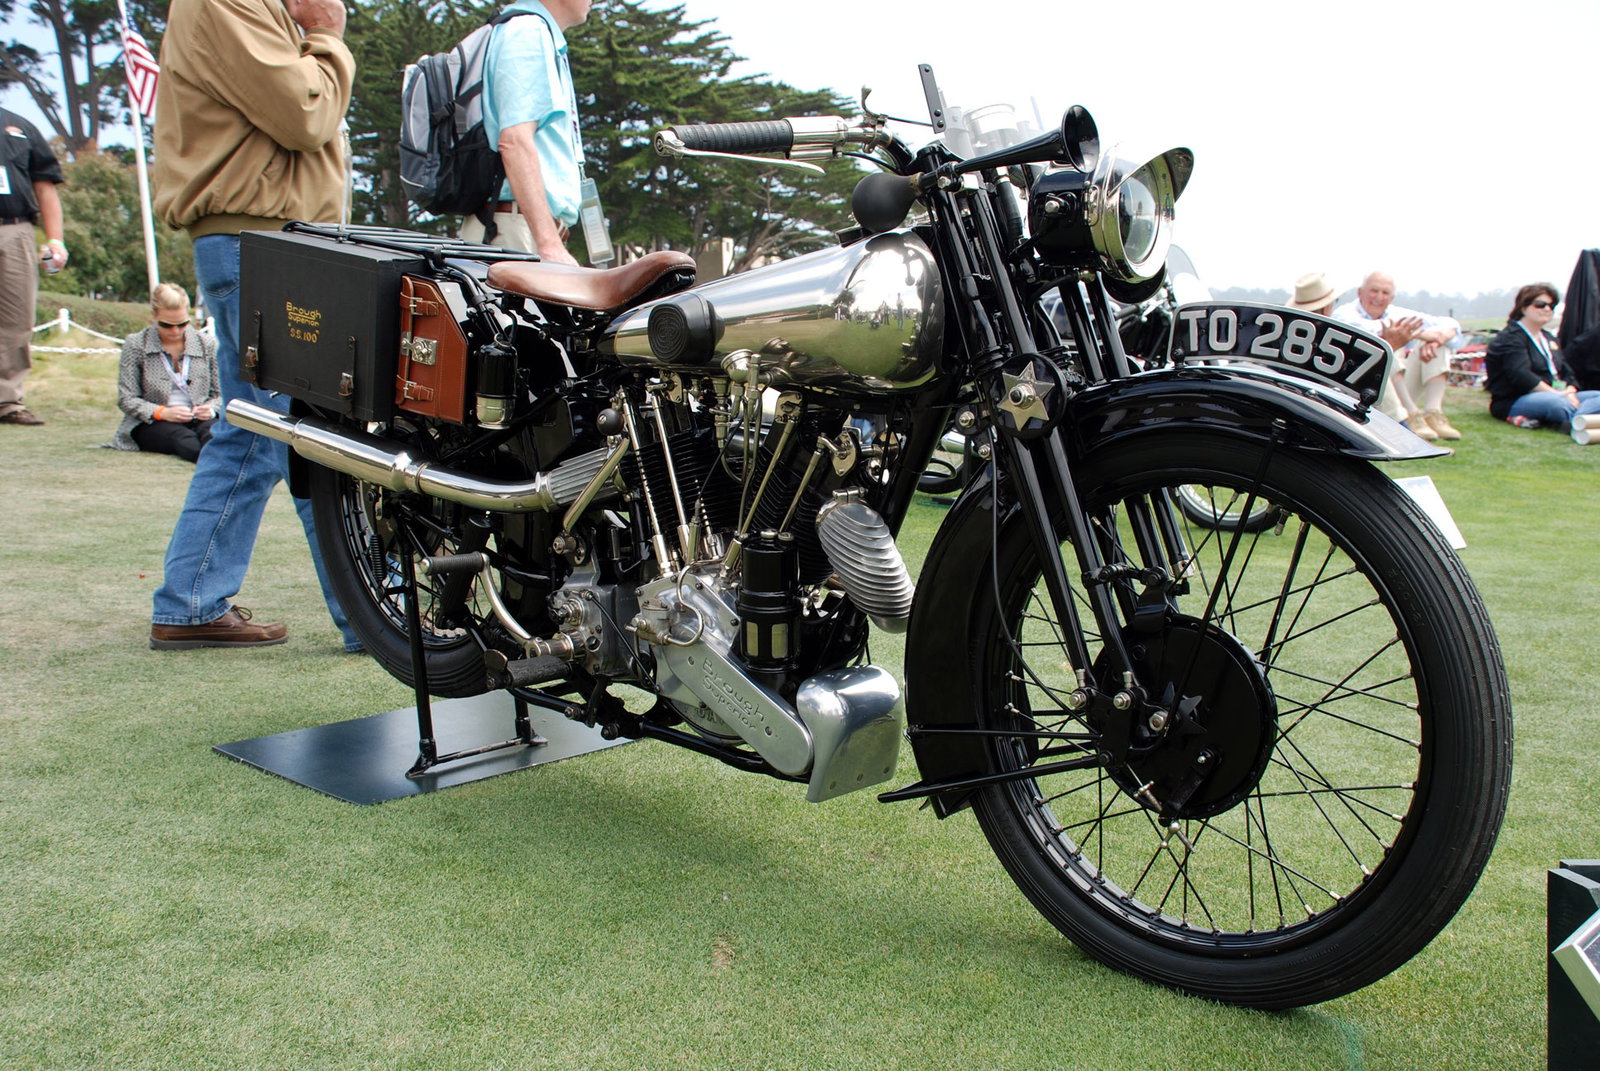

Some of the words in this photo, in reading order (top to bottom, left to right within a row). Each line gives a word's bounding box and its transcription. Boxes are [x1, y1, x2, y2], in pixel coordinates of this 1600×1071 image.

[286, 301, 322, 320] Brough
[287, 312, 320, 327] Superior
[1179, 309, 1238, 352] TO
[1250, 313, 1385, 384] 2857
[702, 657, 766, 722] Brough
[702, 675, 758, 731] Superior
